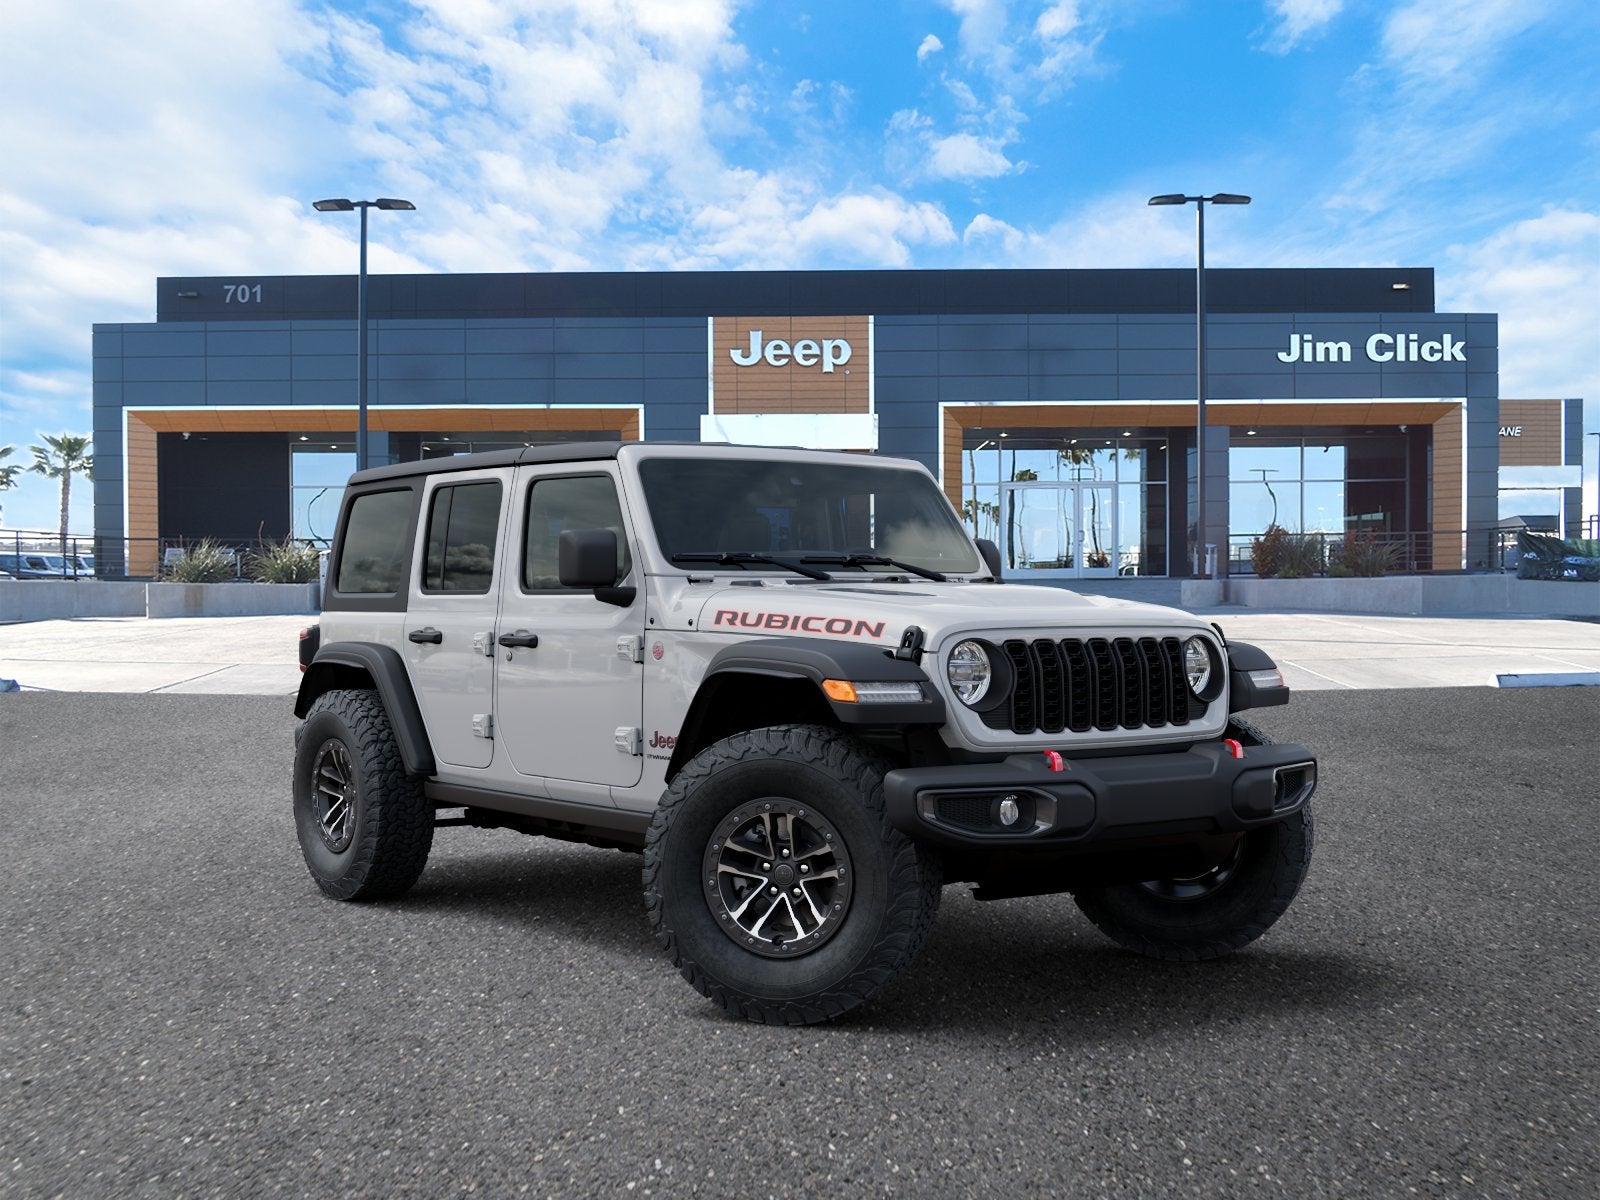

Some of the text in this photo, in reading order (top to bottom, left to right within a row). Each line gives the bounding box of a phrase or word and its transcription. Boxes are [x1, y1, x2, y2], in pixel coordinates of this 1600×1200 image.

[223, 284, 262, 303] 701
[729, 329, 853, 373] Jeep
[1277, 333, 1466, 362] Jim Click
[714, 610, 886, 638] RUBICON
